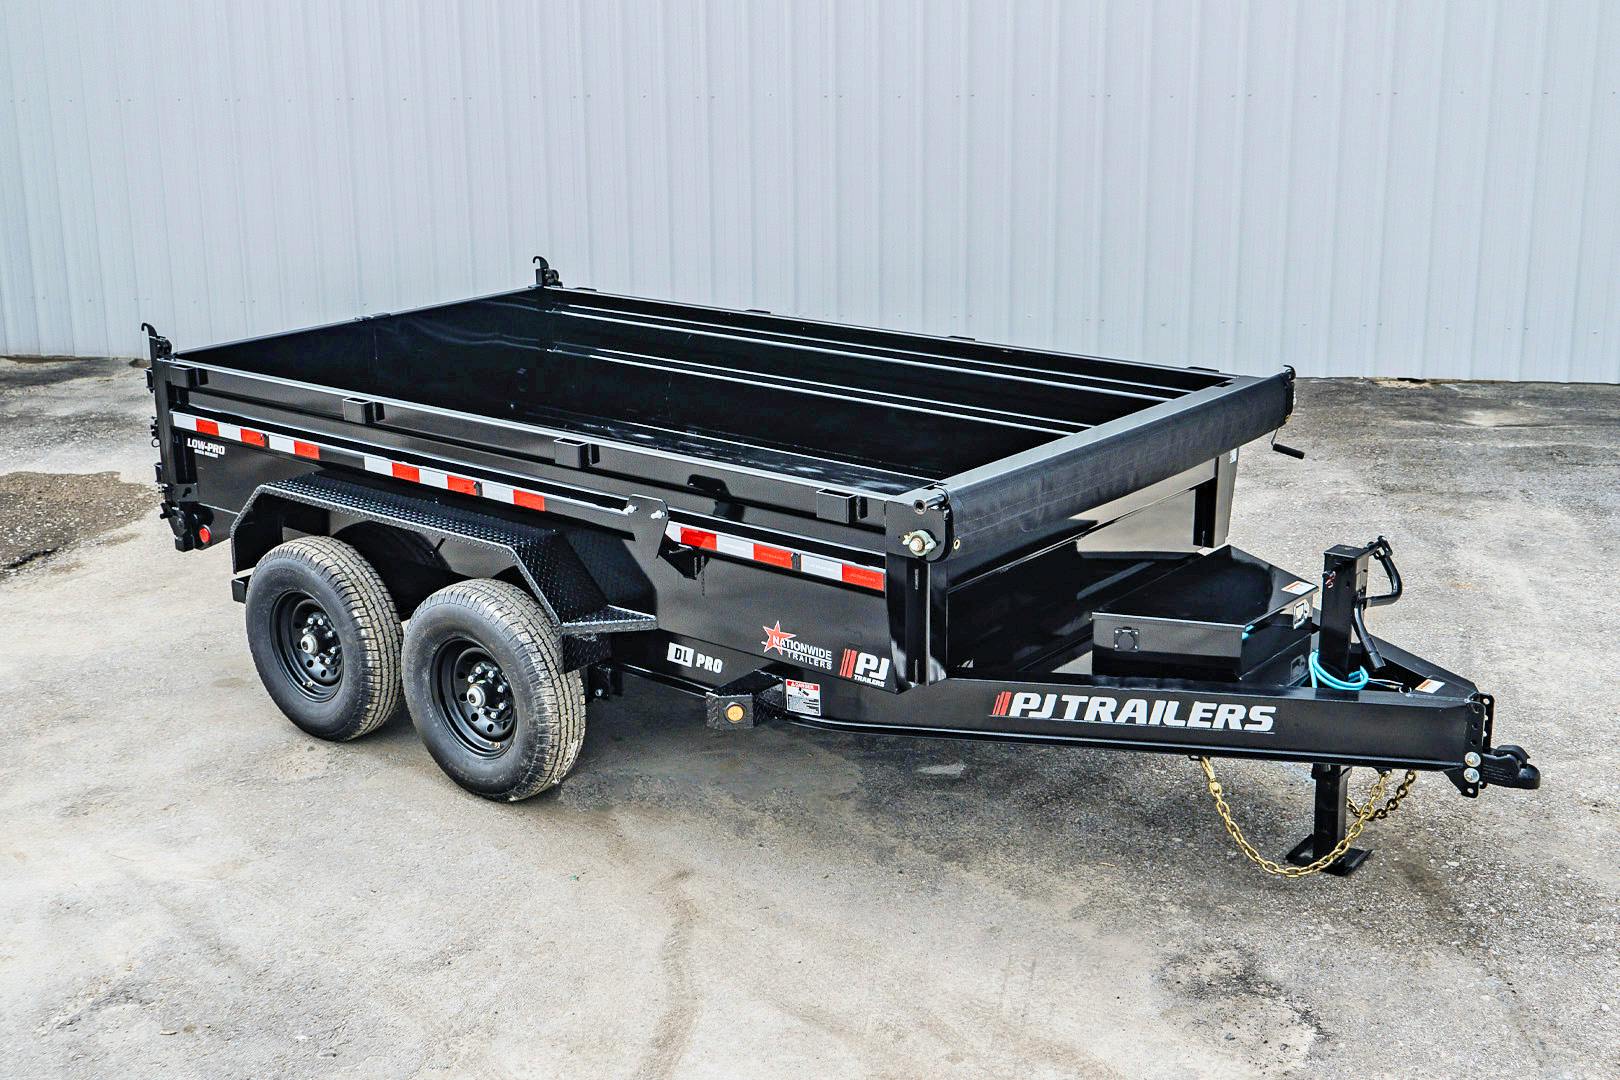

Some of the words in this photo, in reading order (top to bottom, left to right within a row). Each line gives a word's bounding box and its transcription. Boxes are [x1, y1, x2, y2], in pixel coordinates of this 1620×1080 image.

[187, 438, 225, 455] LOW-PRO
[675, 647, 689, 664] DL
[695, 654, 723, 674] PRO
[772, 635, 832, 661] NATIONWIDE
[787, 650, 832, 670] TRAILERS
[854, 652, 890, 681] PJ
[853, 673, 886, 688] TRAILERS
[1009, 692, 1057, 719] PJ
[1061, 694, 1277, 731] TRAILERS
